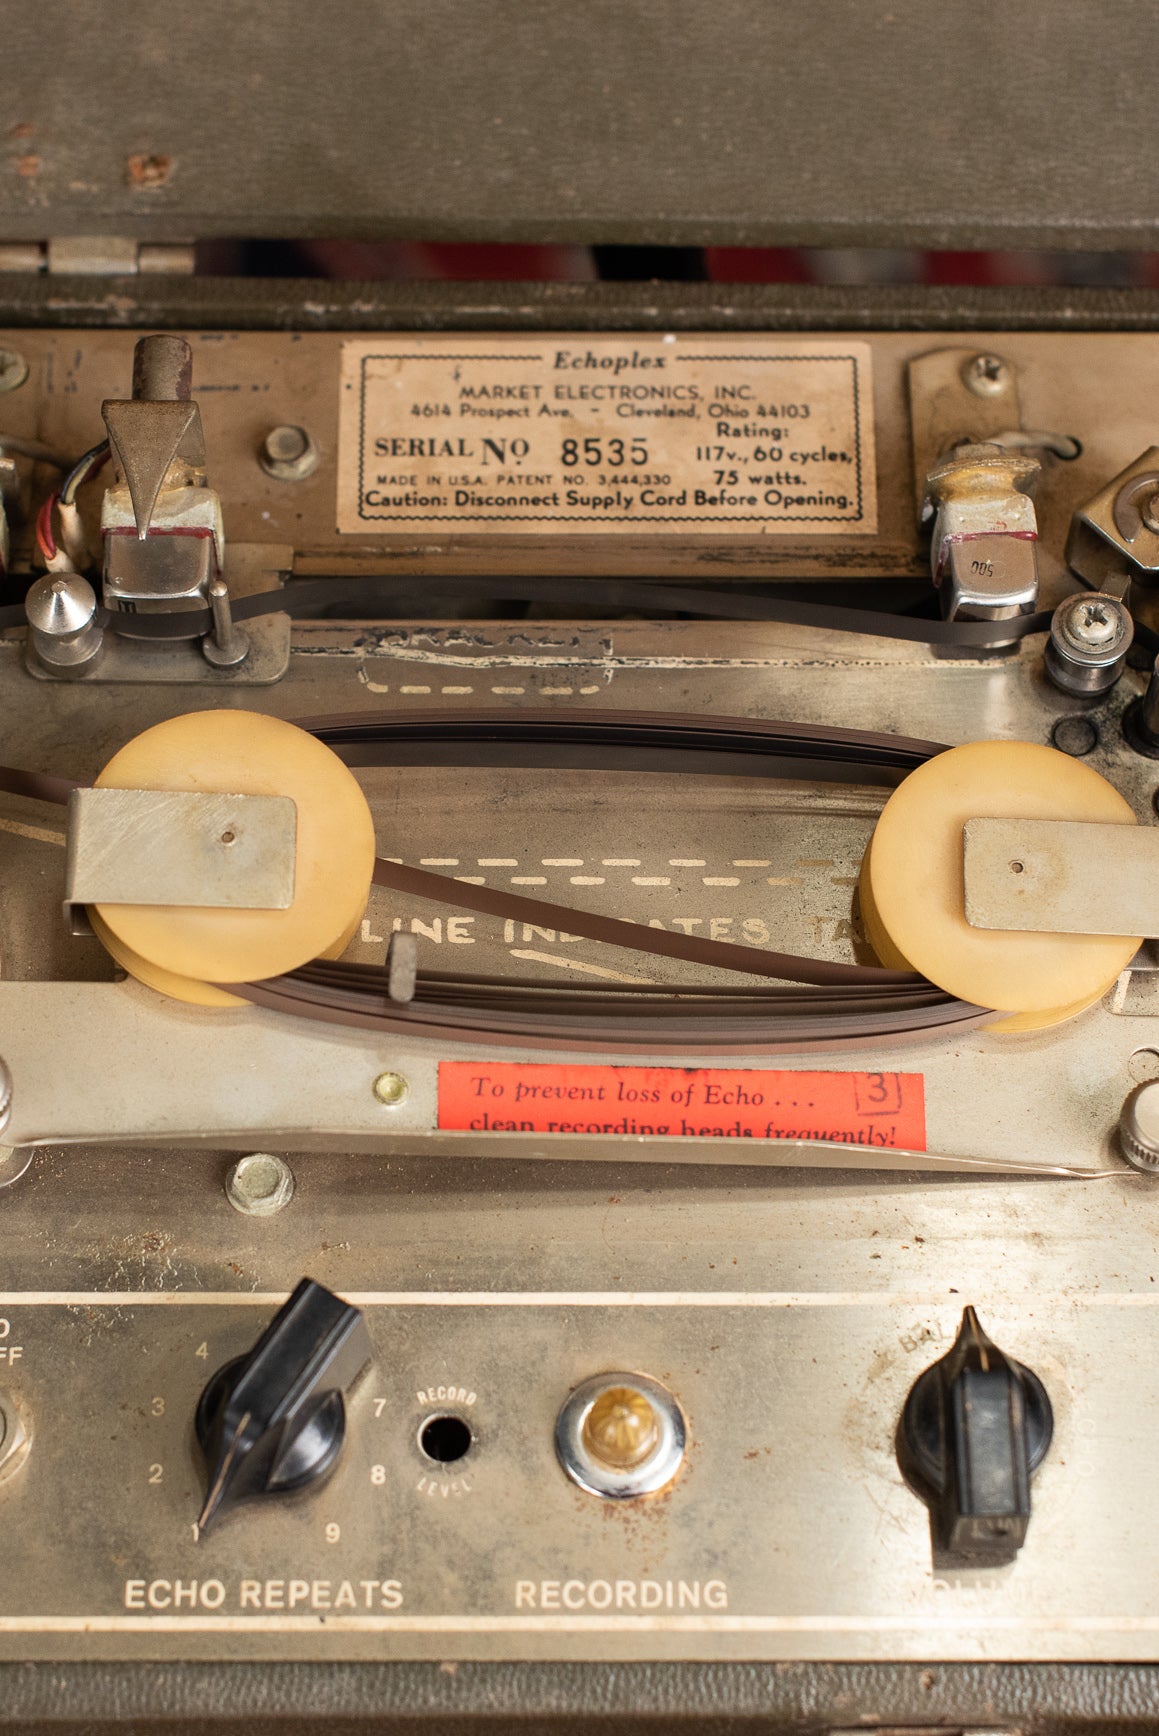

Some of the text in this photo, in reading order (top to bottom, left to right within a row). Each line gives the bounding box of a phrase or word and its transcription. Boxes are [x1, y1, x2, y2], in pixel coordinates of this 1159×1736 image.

[553, 351, 667, 375] Echoplex
[458, 385, 757, 402] MARKET ELECTRONICS, INC.
[410, 403, 451, 417] 4614
[460, 402, 529, 420] Prospect
[616, 403, 701, 420] Cleveland,
[708, 403, 749, 418] Ohio
[756, 404, 811, 419] 44103
[716, 421, 789, 440] Rating:
[373, 437, 474, 457] SERIAL
[560, 438, 649, 466] 8535
[753, 446, 783, 462] 60
[377, 475, 418, 486] MADE
[426, 475, 441, 486] IN
[448, 475, 487, 487] U.S.A.
[496, 474, 553, 486] PATENT
[598, 474, 672, 488] 3,444,330
[713, 469, 808, 486] 75 watts.
[364, 489, 854, 510] Caution: Disconnect Supply Cord Before Opening.
[361, 916, 476, 944] LINE
[471, 1077, 505, 1098] To
[515, 1080, 606, 1102] prevent
[617, 1082, 661, 1103] loss
[671, 1083, 696, 1107] of
[703, 1084, 764, 1107] Echo
[469, 1112, 535, 1132] clean
[547, 1117, 670, 1136] recording
[680, 1119, 753, 1138] heads
[195, 1342, 209, 1359] 4
[151, 1397, 166, 1417] 3
[416, 1385, 478, 1407] RECORD
[373, 1397, 388, 1418] 7
[148, 1463, 164, 1485] 2
[370, 1464, 387, 1486] 8
[416, 1476, 473, 1498] LEVEL
[190, 1521, 200, 1543] 1
[325, 1522, 341, 1544] 9
[124, 1578, 405, 1609] ECHO REPEATS
[514, 1579, 730, 1609] RECORDING
